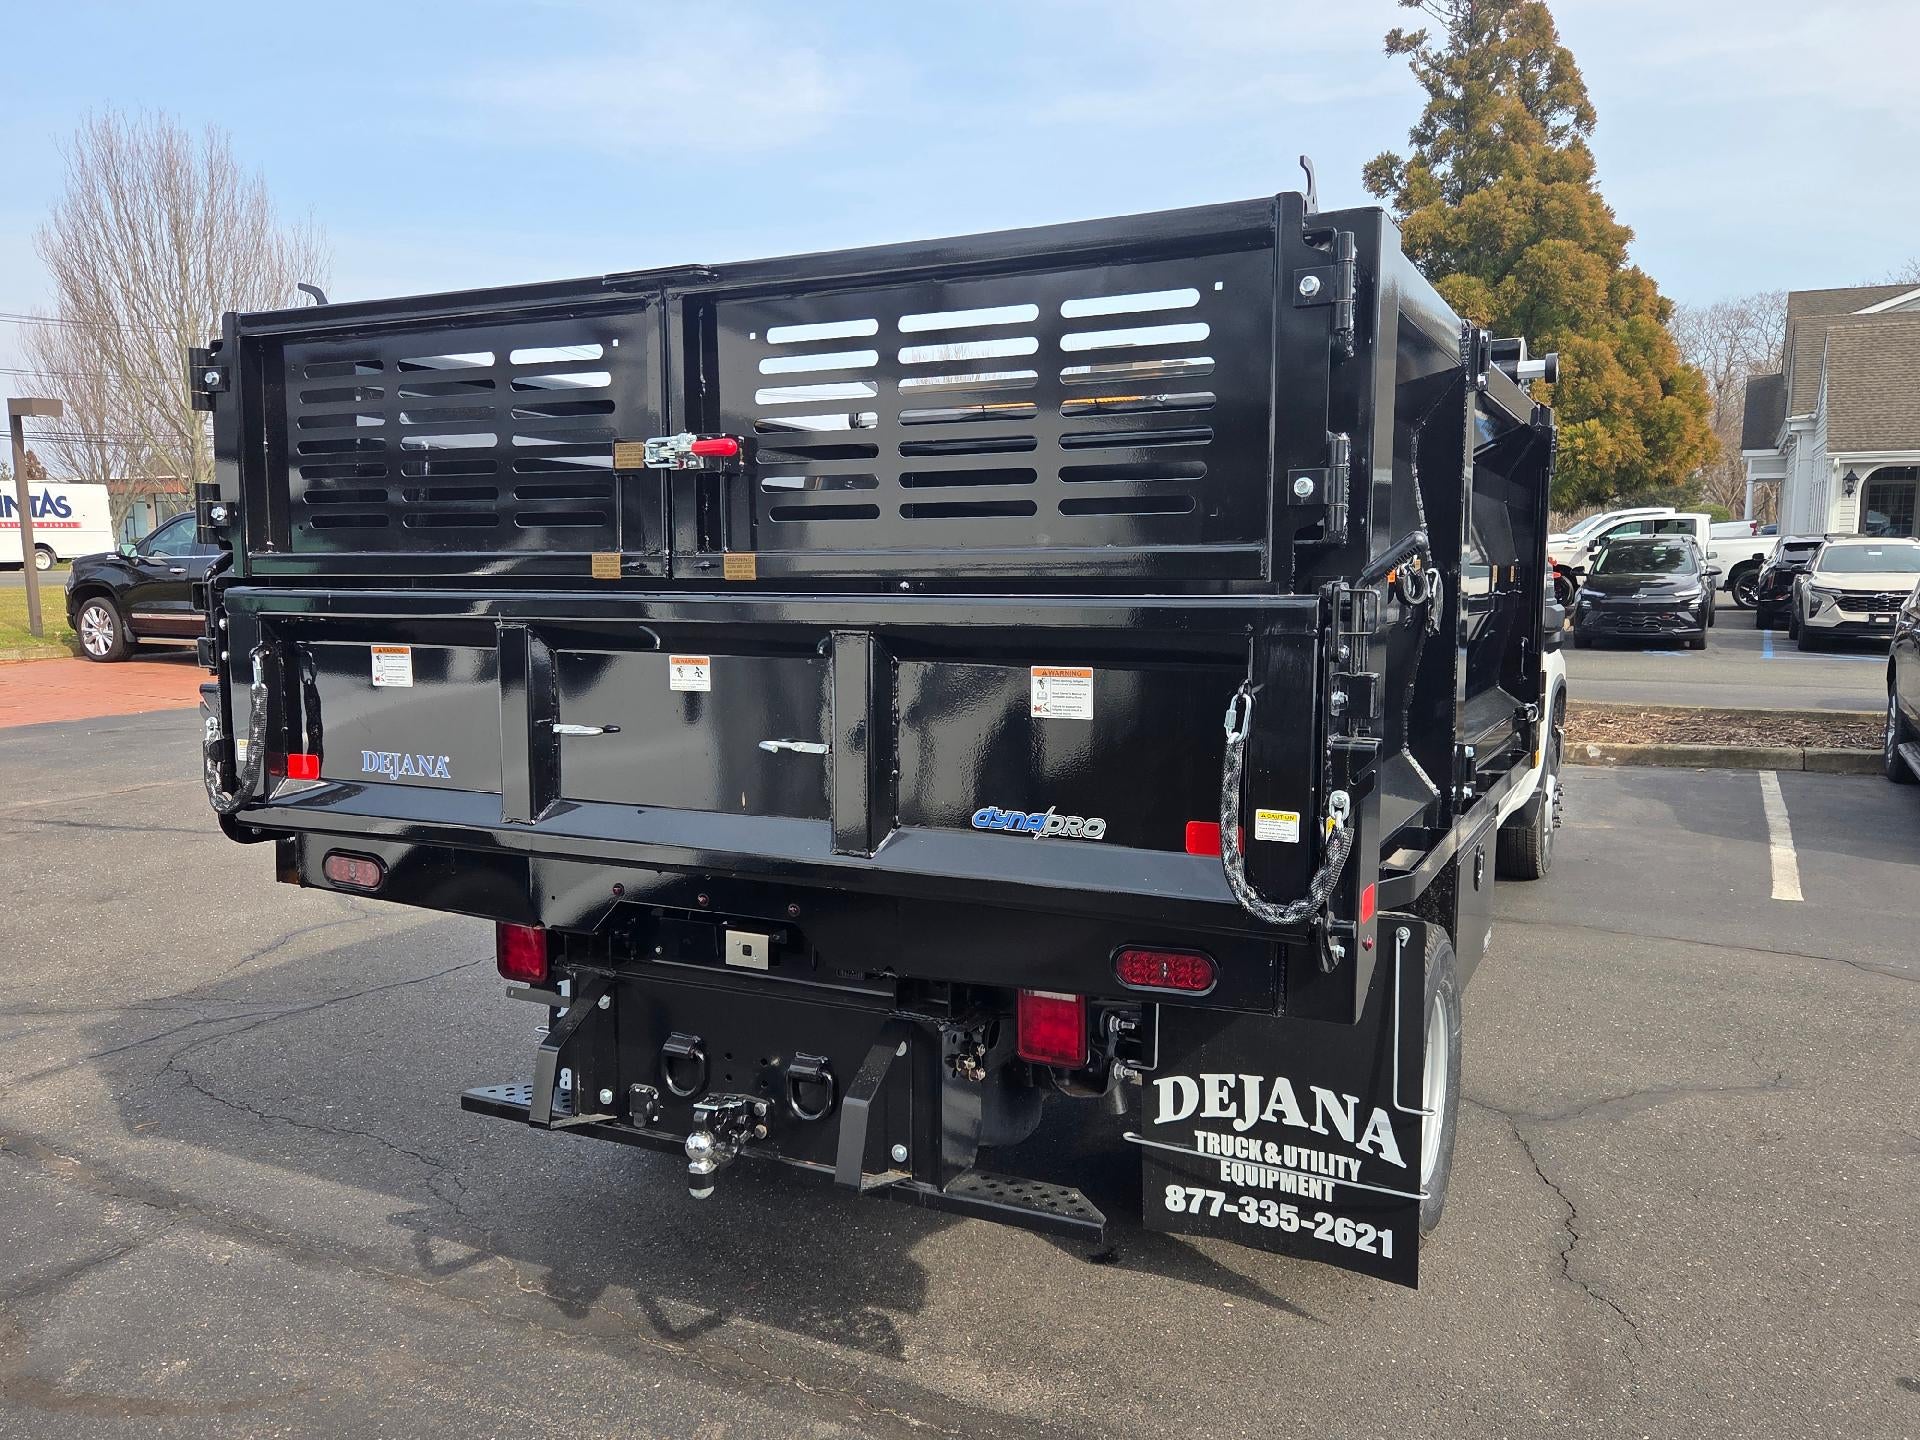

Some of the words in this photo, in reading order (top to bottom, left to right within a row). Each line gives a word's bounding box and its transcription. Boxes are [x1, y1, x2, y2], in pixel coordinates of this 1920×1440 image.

[1153, 1073, 1407, 1168] DEJANA
[1220, 1160, 1335, 1202] EQUIPMENT
[1164, 1185, 1393, 1259] 877-335-2621
